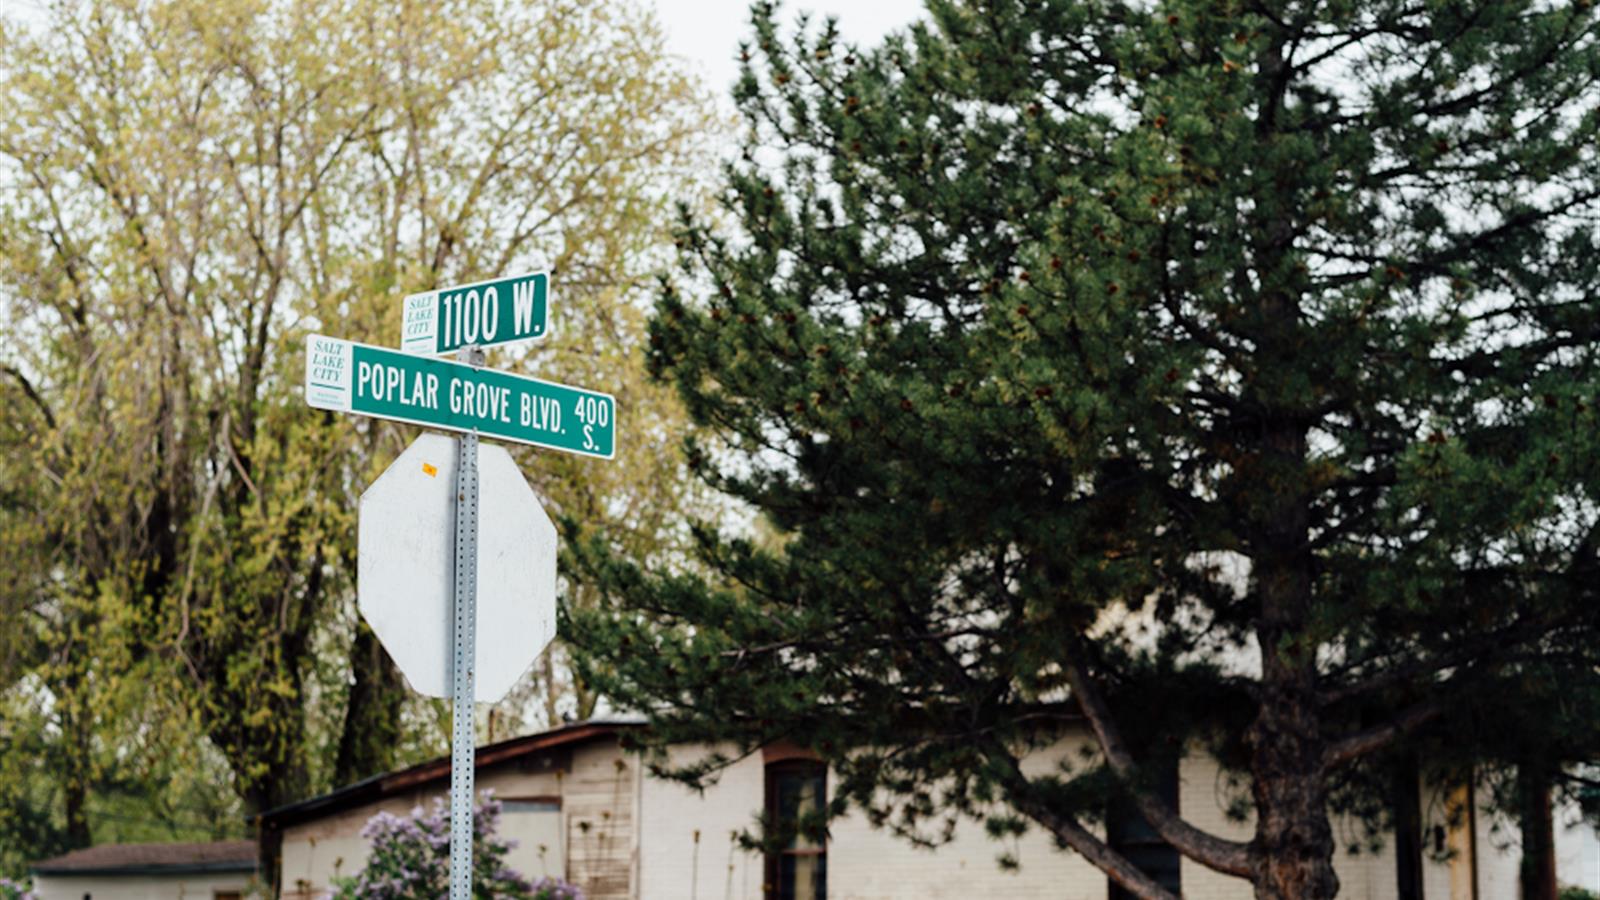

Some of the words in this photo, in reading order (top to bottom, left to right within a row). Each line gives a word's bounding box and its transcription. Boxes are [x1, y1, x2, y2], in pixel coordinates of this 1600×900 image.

[409, 295, 433, 310] SALT
[408, 308, 433, 323] LAKE
[443, 286, 499, 348] 1100
[513, 280, 540, 336] W.
[407, 321, 432, 335] CITY
[314, 340, 344, 355] SALT
[312, 353, 344, 369] LAKE
[313, 367, 342, 382] CITY
[358, 361, 439, 410] POPLAR
[450, 377, 511, 424] GROVE
[520, 392, 566, 435] BLVD.
[574, 395, 608, 427] 400
[582, 424, 600, 451] S.
